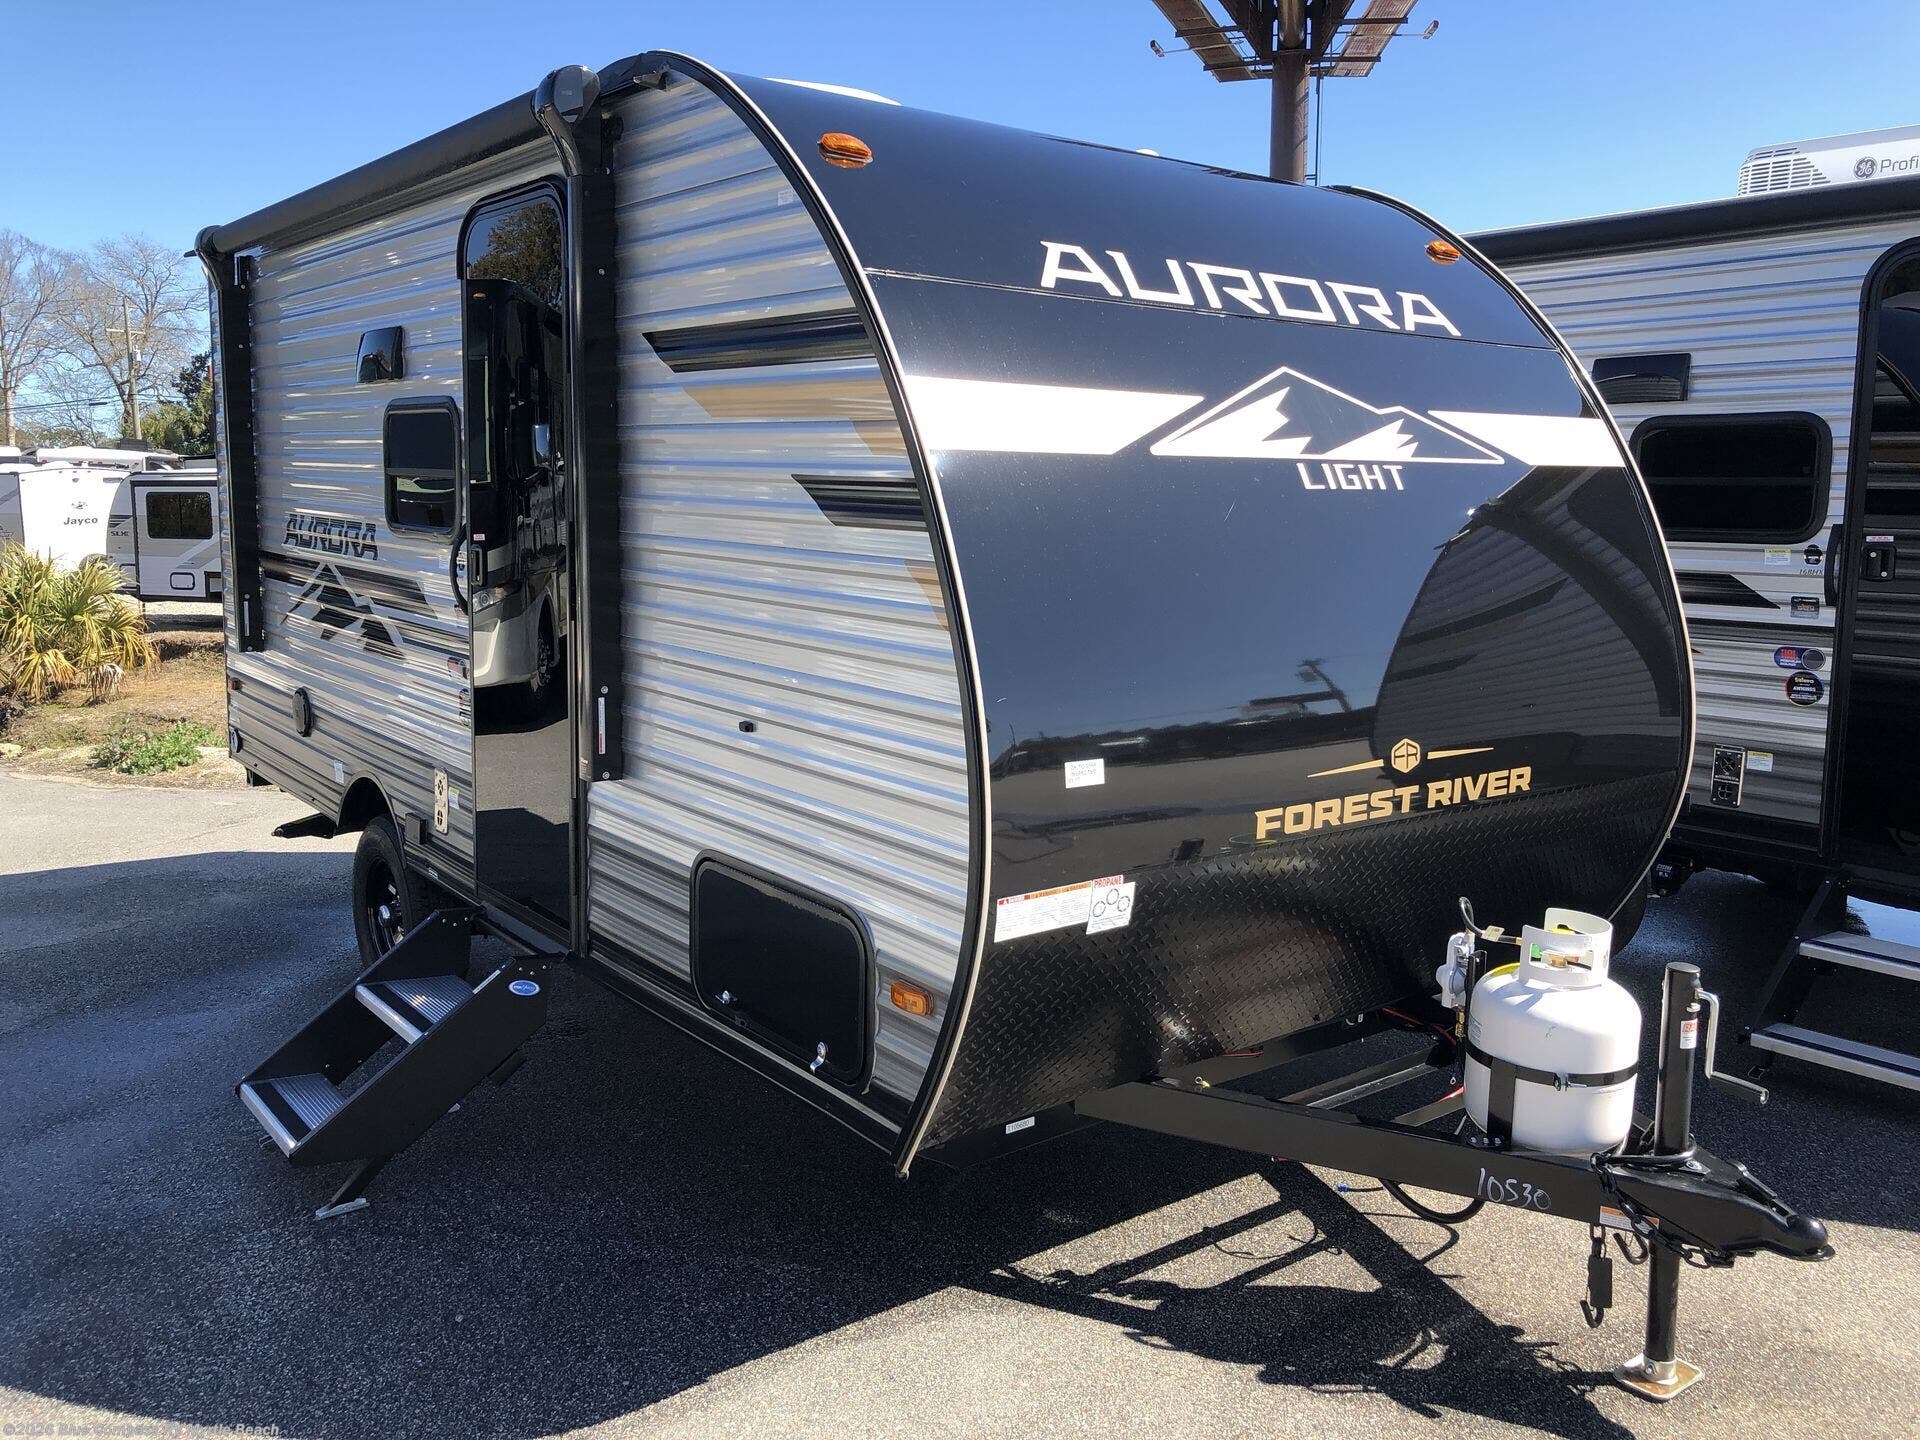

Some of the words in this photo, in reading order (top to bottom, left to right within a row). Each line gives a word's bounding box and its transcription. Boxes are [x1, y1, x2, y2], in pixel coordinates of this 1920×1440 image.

[1040, 241, 1462, 337] AURORA
[1296, 462, 1404, 490] LIGHT
[63, 517, 98, 526] Jayco
[283, 513, 378, 560] AURORA
[1255, 785, 1420, 840] FOREST
[1427, 766, 1532, 808] RIVER
[1094, 875, 1122, 889] PROPANE
[1477, 1167, 1551, 1211] 10530
